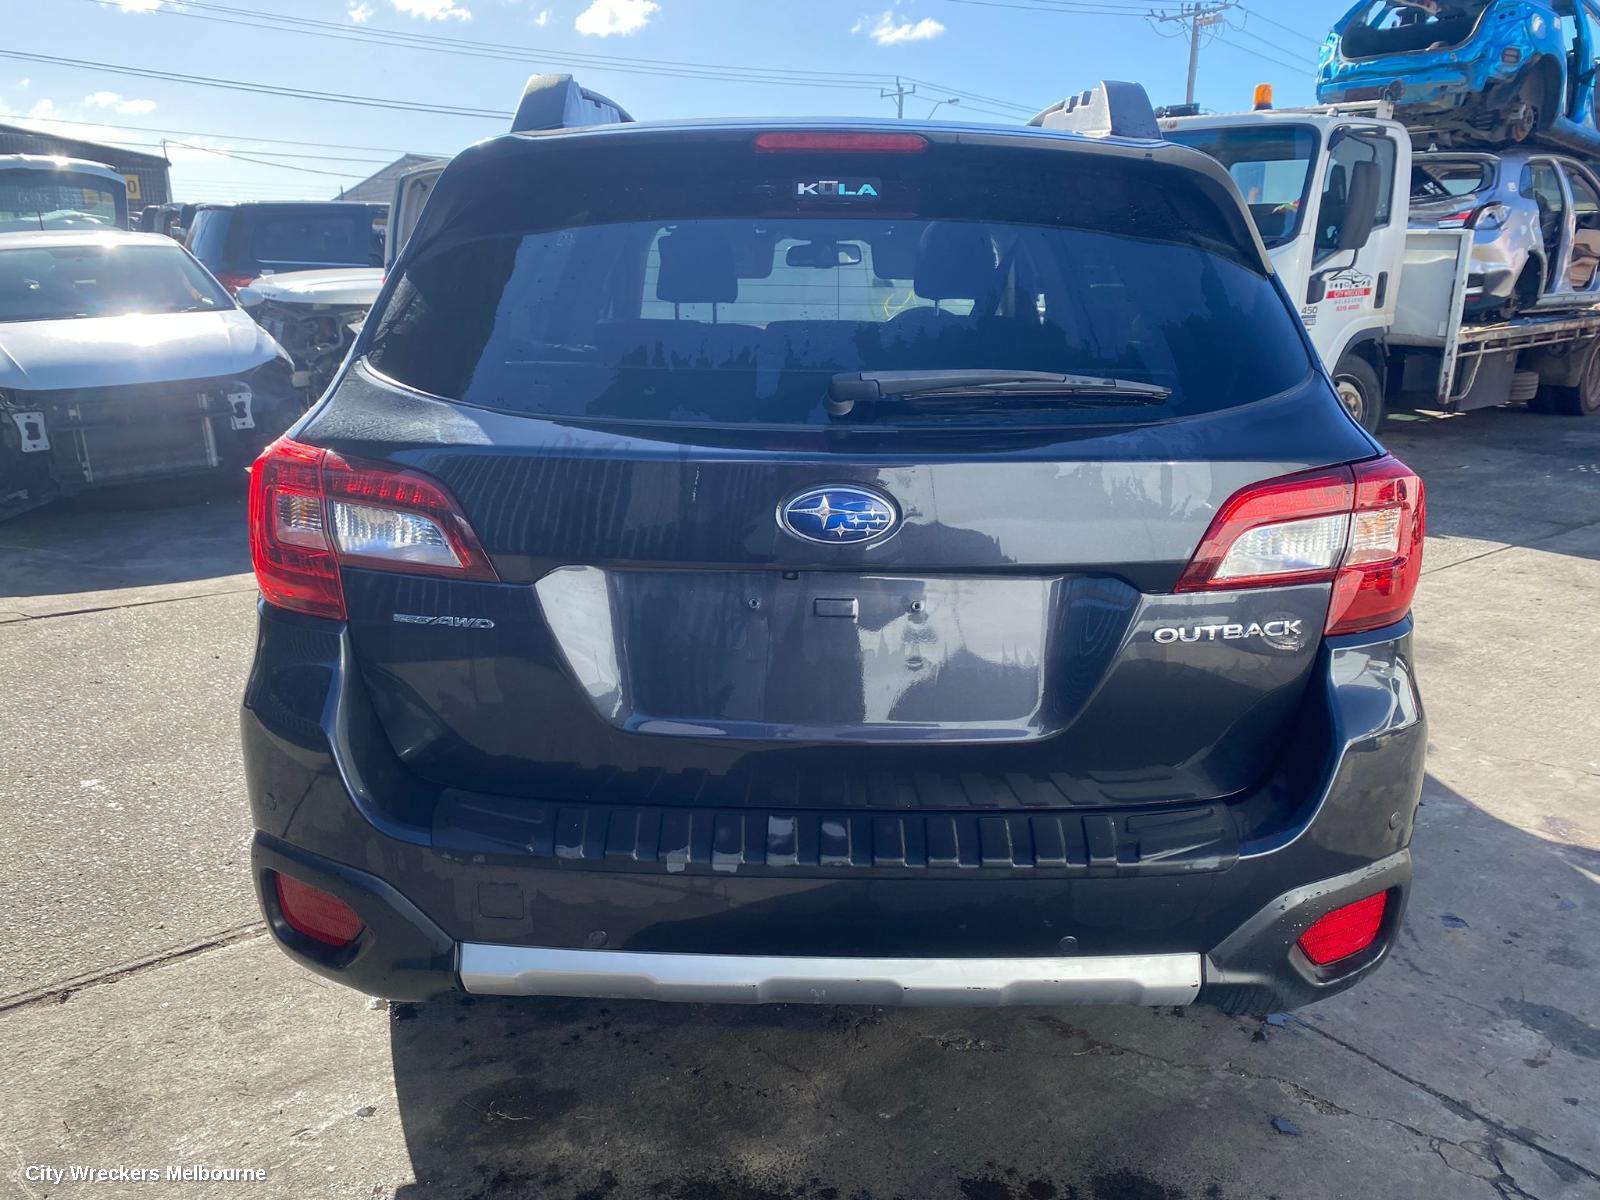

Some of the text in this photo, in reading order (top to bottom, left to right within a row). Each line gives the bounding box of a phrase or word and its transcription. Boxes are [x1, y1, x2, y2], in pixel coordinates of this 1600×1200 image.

[1301, 306, 1318, 315] 450
[429, 616, 495, 628] AWD
[1153, 619, 1302, 644] OUTBACK
